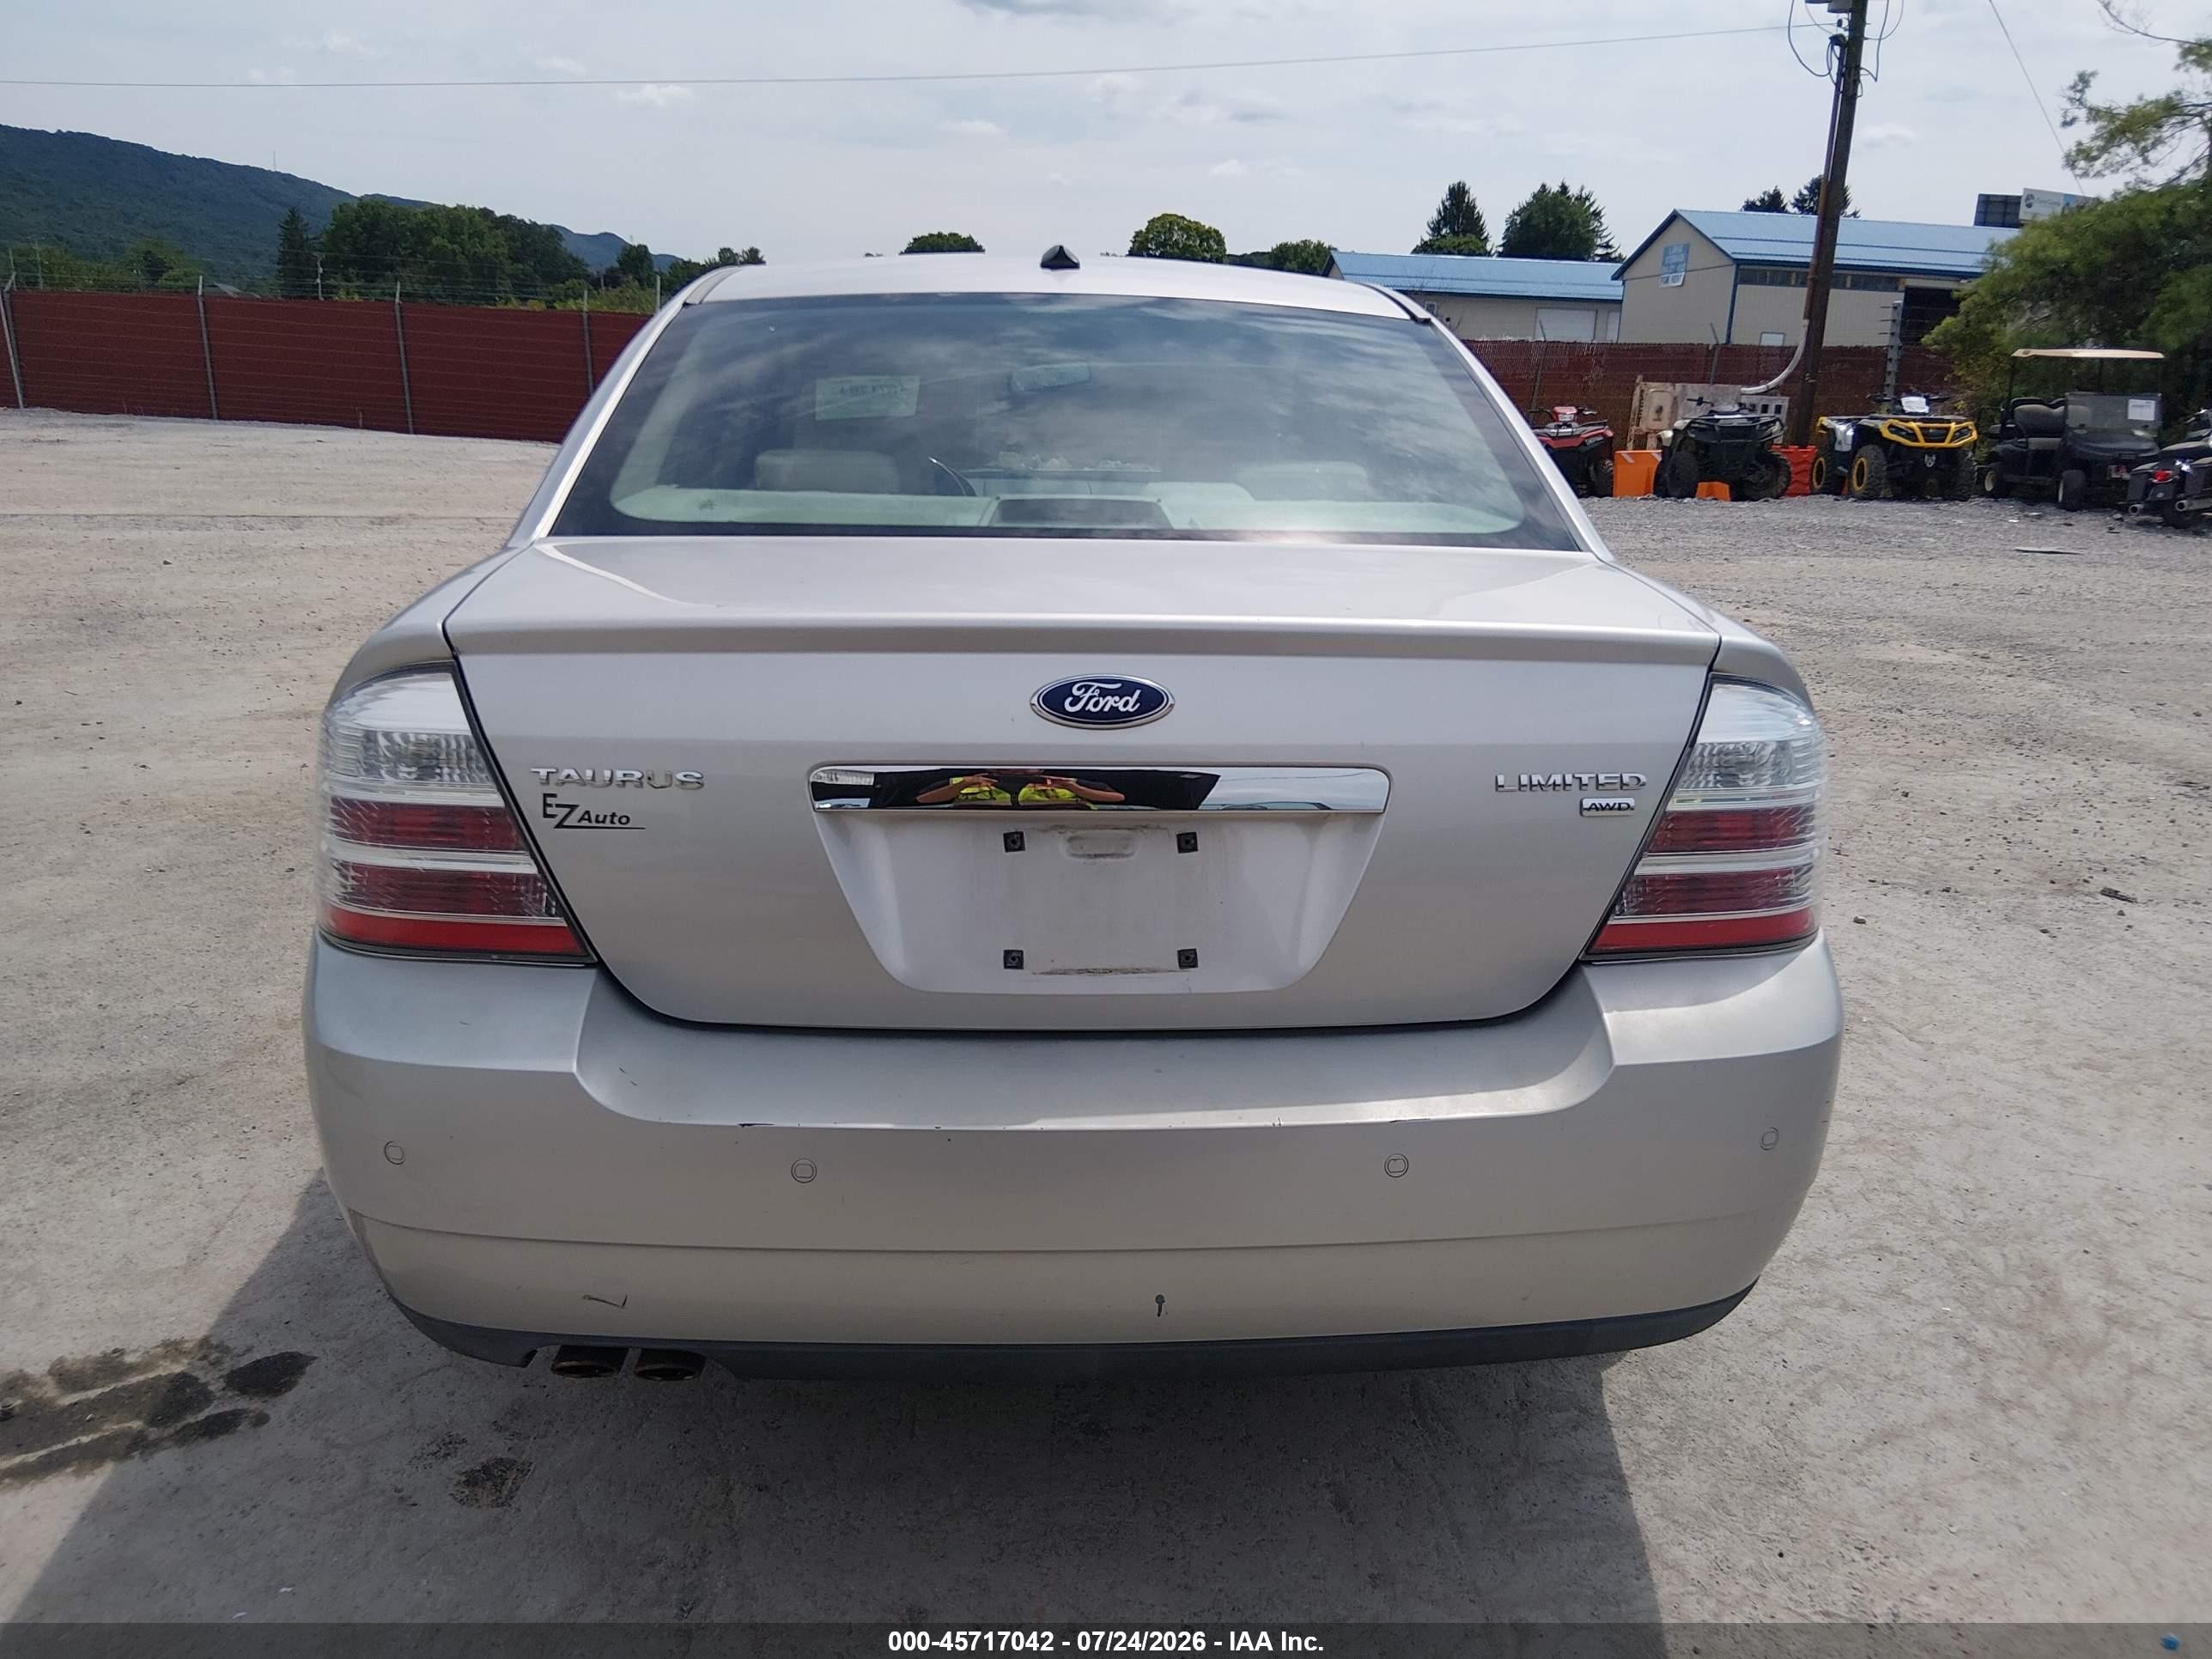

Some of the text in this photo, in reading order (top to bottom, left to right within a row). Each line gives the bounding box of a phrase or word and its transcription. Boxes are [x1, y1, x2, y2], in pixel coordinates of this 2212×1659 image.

[1064, 681, 1142, 713] Ford
[530, 767, 705, 791] TAURUS
[1494, 772, 1648, 792] LIMITED
[542, 793, 631, 829] EZ Auto
[1586, 801, 1632, 811] AWD
